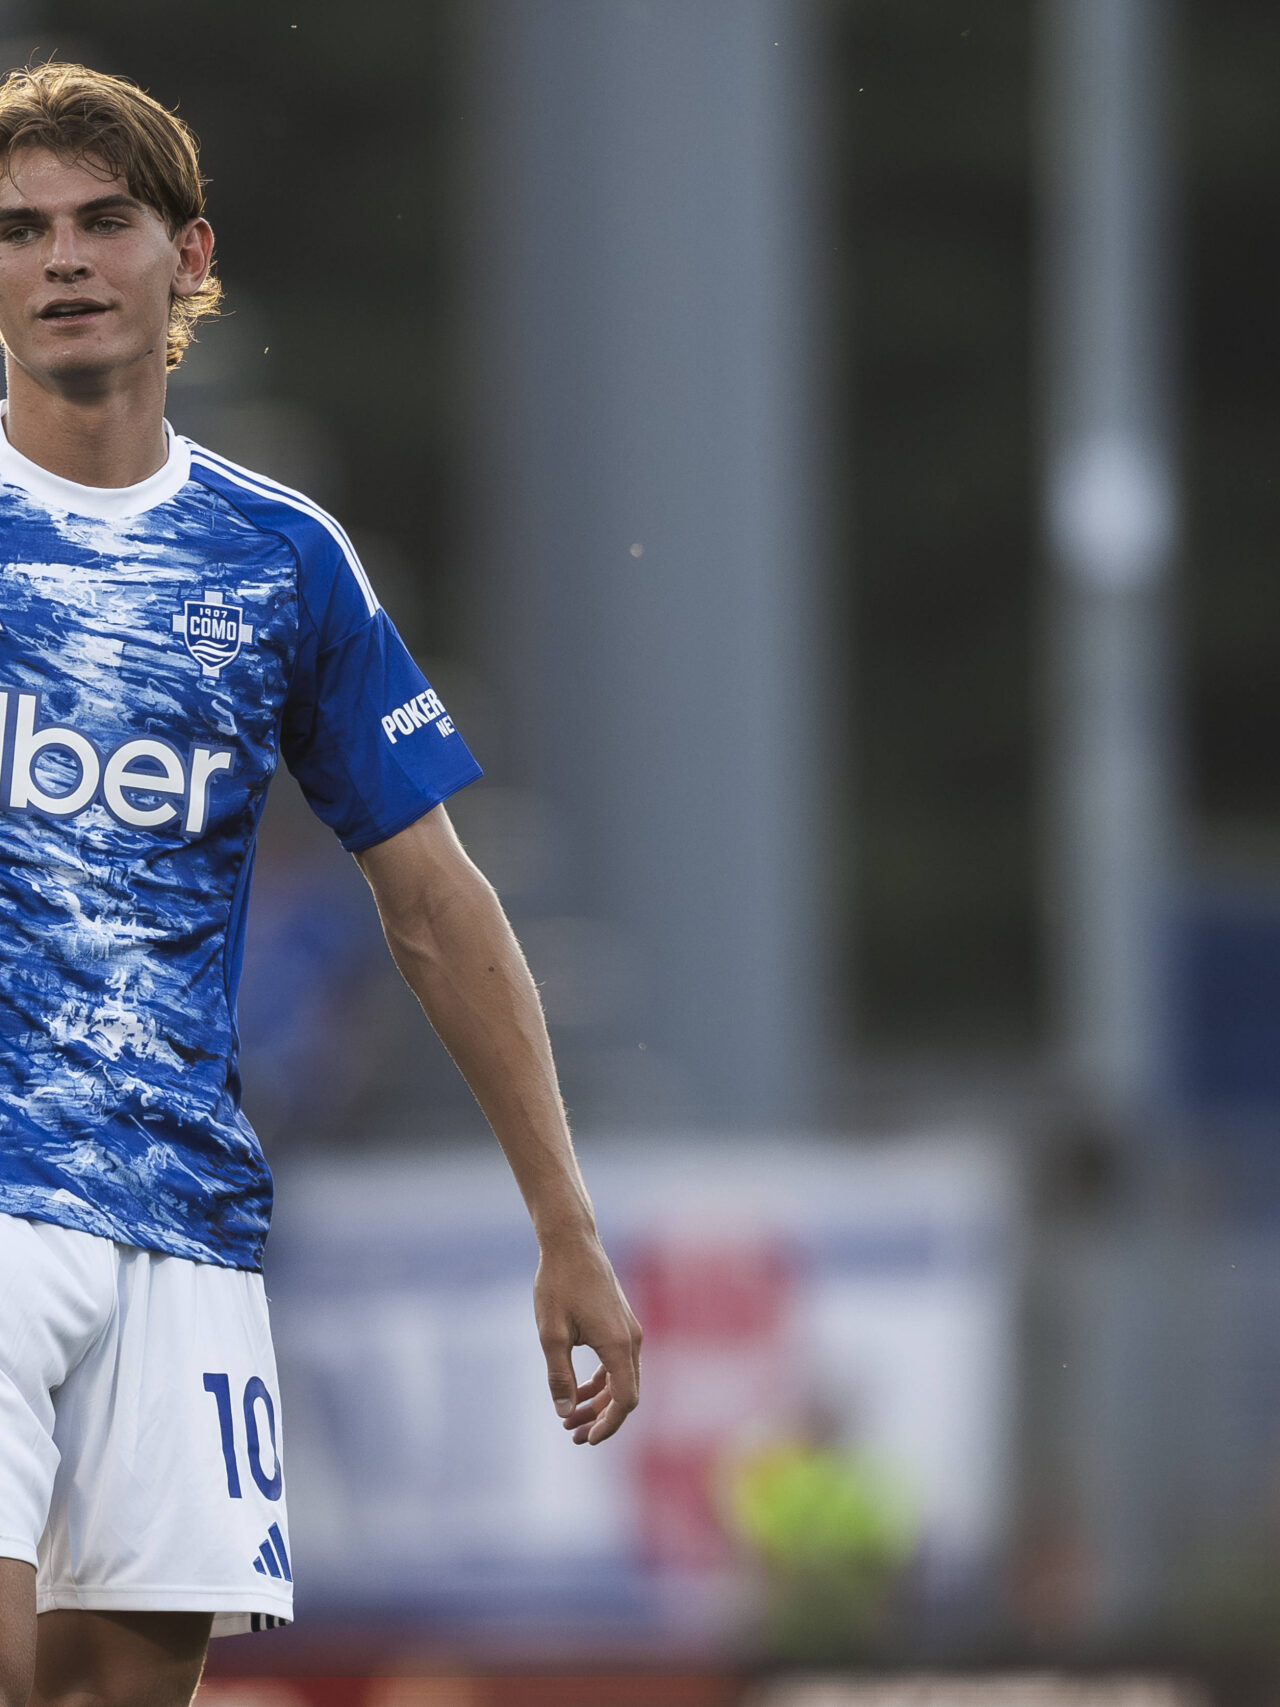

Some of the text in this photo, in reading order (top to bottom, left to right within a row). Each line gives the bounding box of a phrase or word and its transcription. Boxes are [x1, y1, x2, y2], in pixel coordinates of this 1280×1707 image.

[200, 607, 228, 618] 1907
[190, 616, 237, 641] COMO
[381, 688, 446, 744] POKER
[435, 715, 456, 738] NE
[203, 1373, 282, 1501] 10
